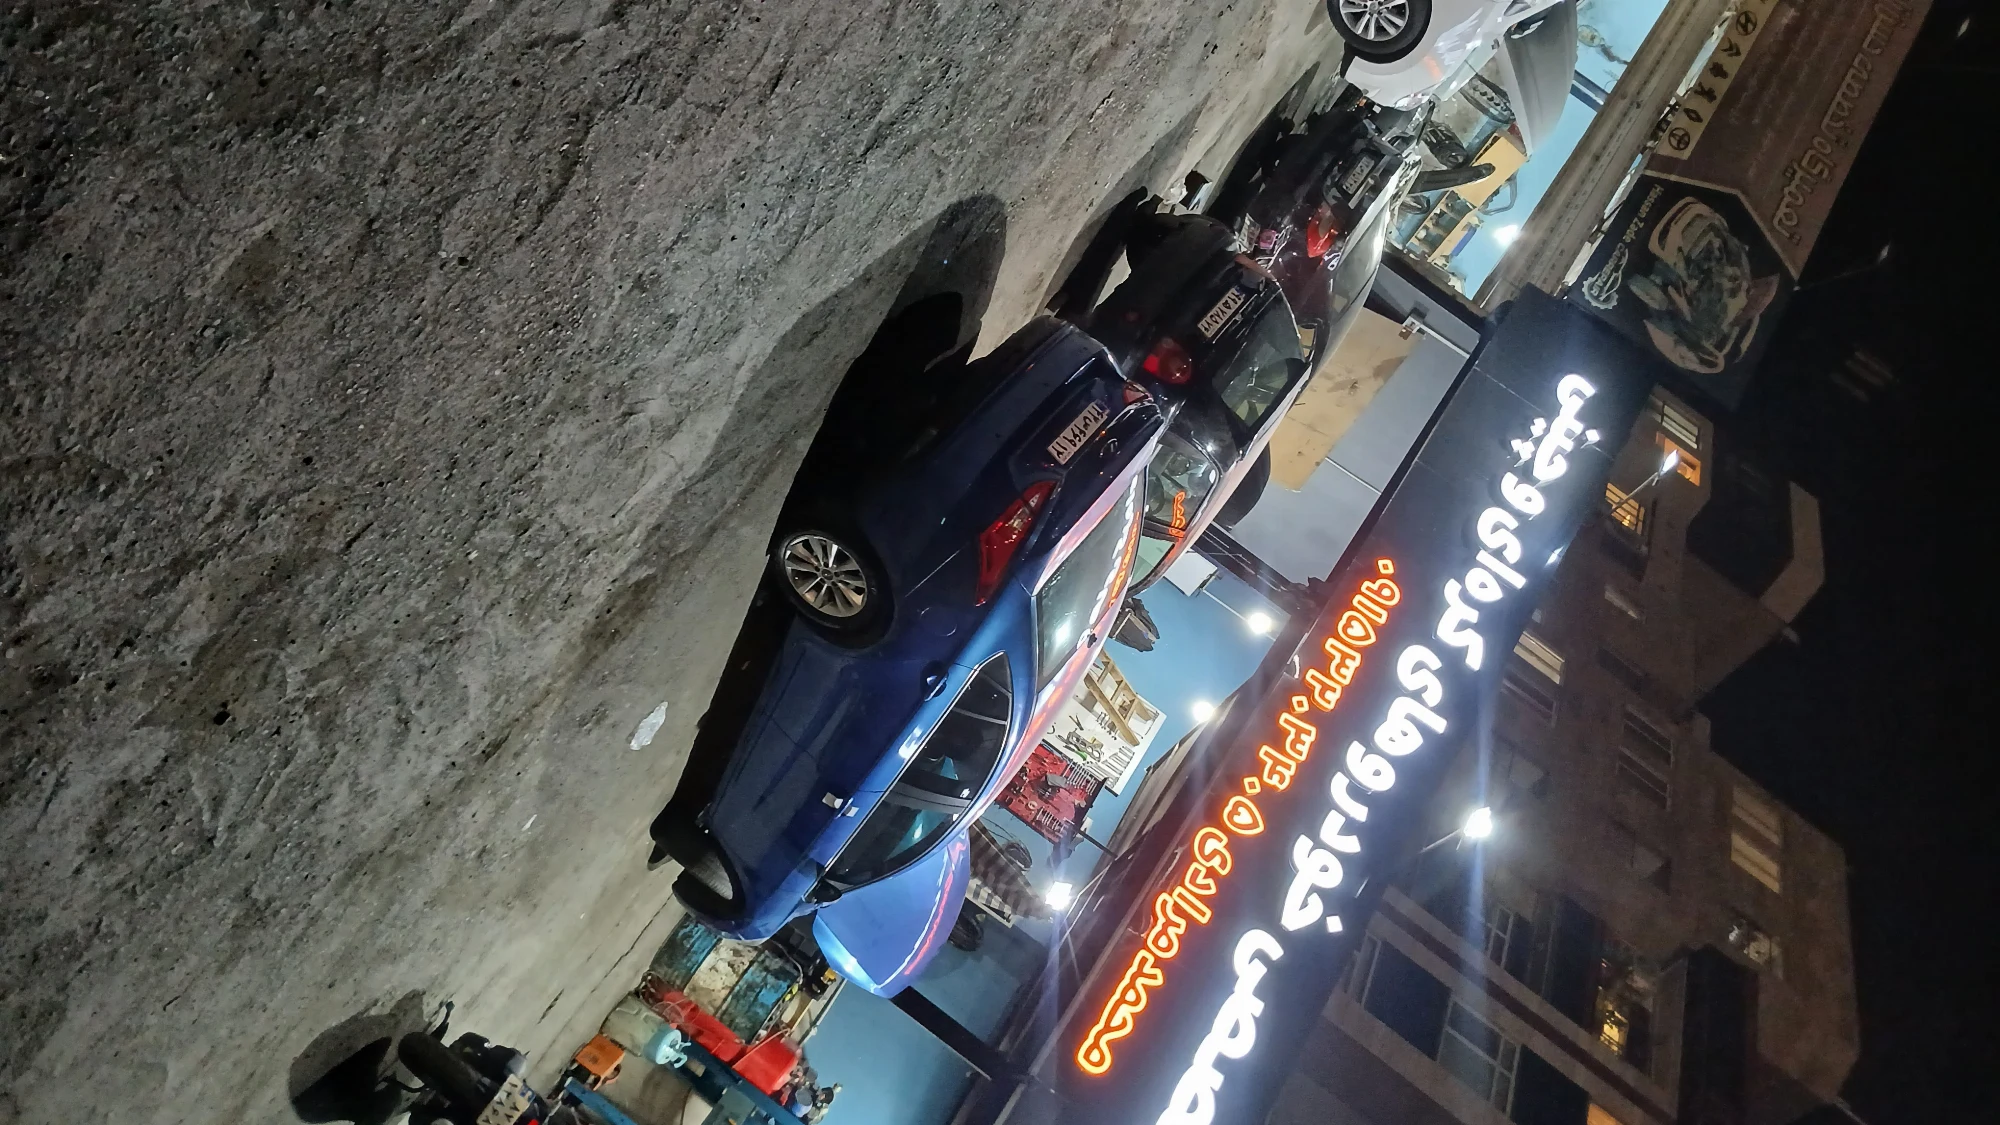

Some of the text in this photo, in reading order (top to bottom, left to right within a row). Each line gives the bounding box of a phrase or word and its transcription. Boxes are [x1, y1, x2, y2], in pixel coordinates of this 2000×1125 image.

[1622, 183, 1665, 243] Hassan Zade
[1772, 135, 1837, 246] تعمیرگاه
[1820, 52, 1874, 148] تخصصی
[1590, 242, 1626, 297] CARREPAIR
[1500, 471, 1545, 521] و
[1510, 374, 1600, 485] چینی
[1280, 644, 1448, 933] خودروهای
[1074, 945, 1165, 1076] محمد
[1145, 826, 1234, 960] مرادی
[1154, 929, 1285, 1125] صصی
